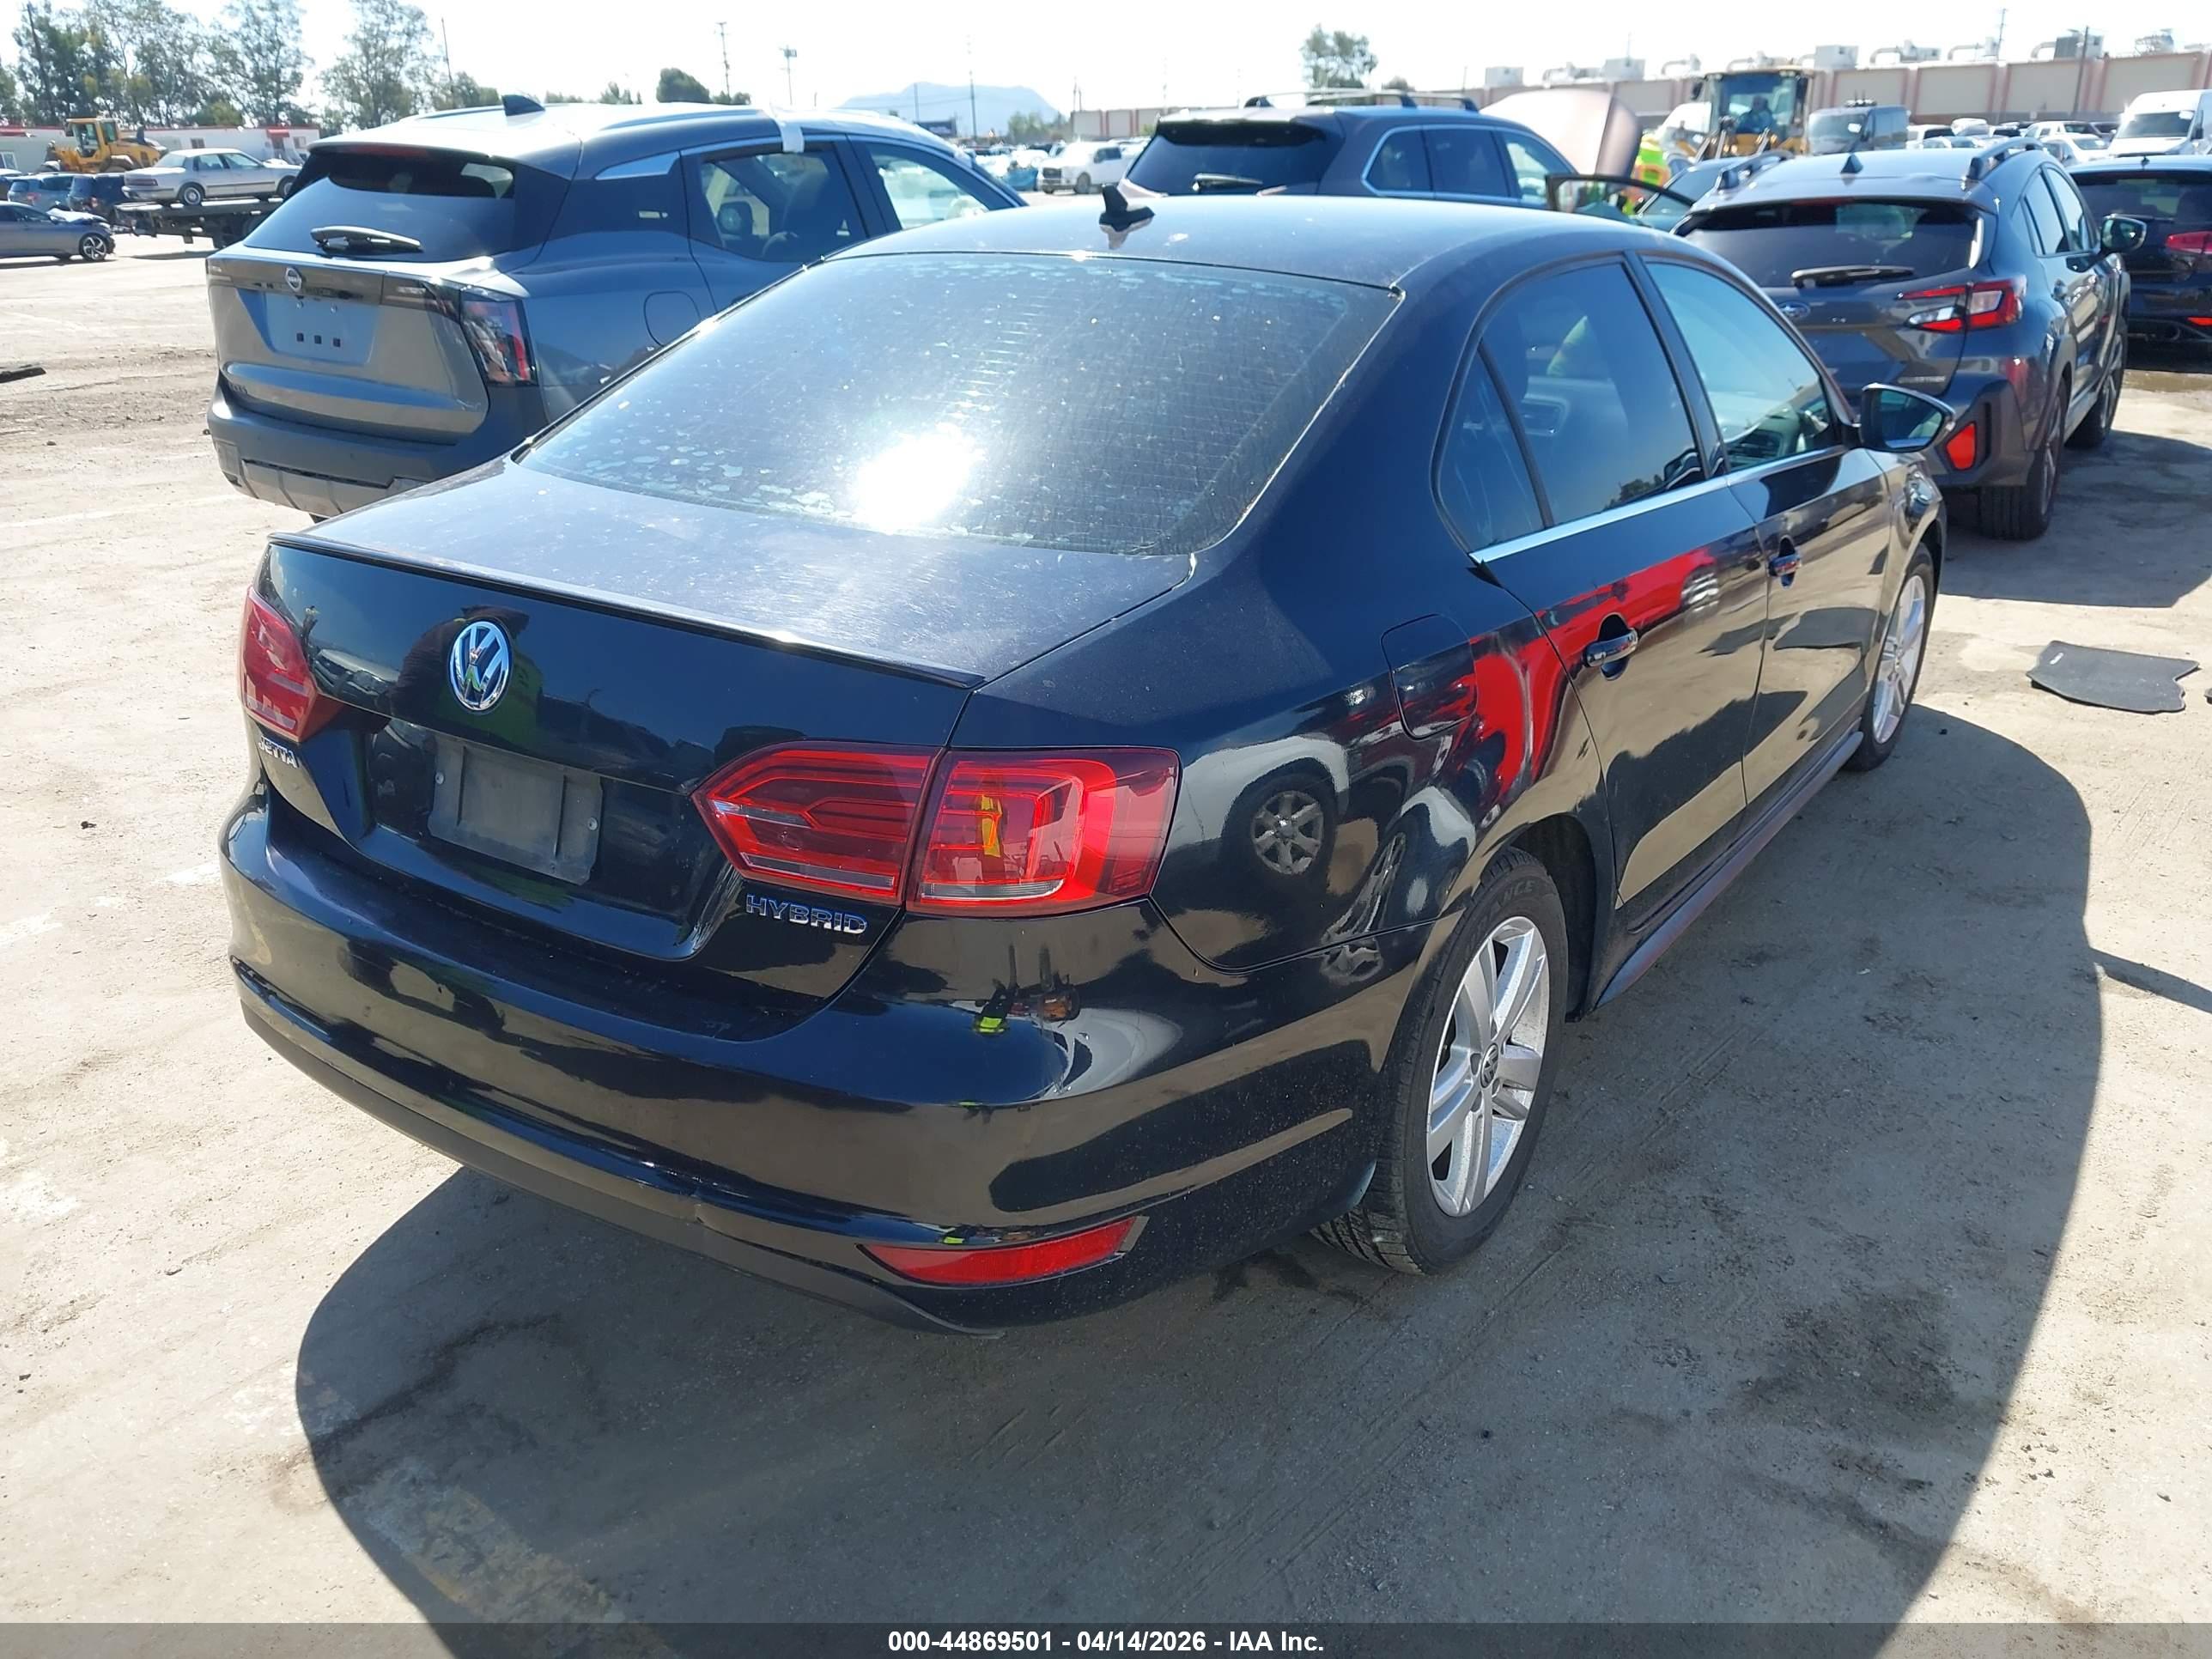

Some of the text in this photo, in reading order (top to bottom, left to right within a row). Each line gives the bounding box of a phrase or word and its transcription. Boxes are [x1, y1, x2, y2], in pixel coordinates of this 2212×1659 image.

[450, 621, 509, 711] VW
[258, 735, 299, 769] JETTA
[746, 894, 867, 934] HYBRID
